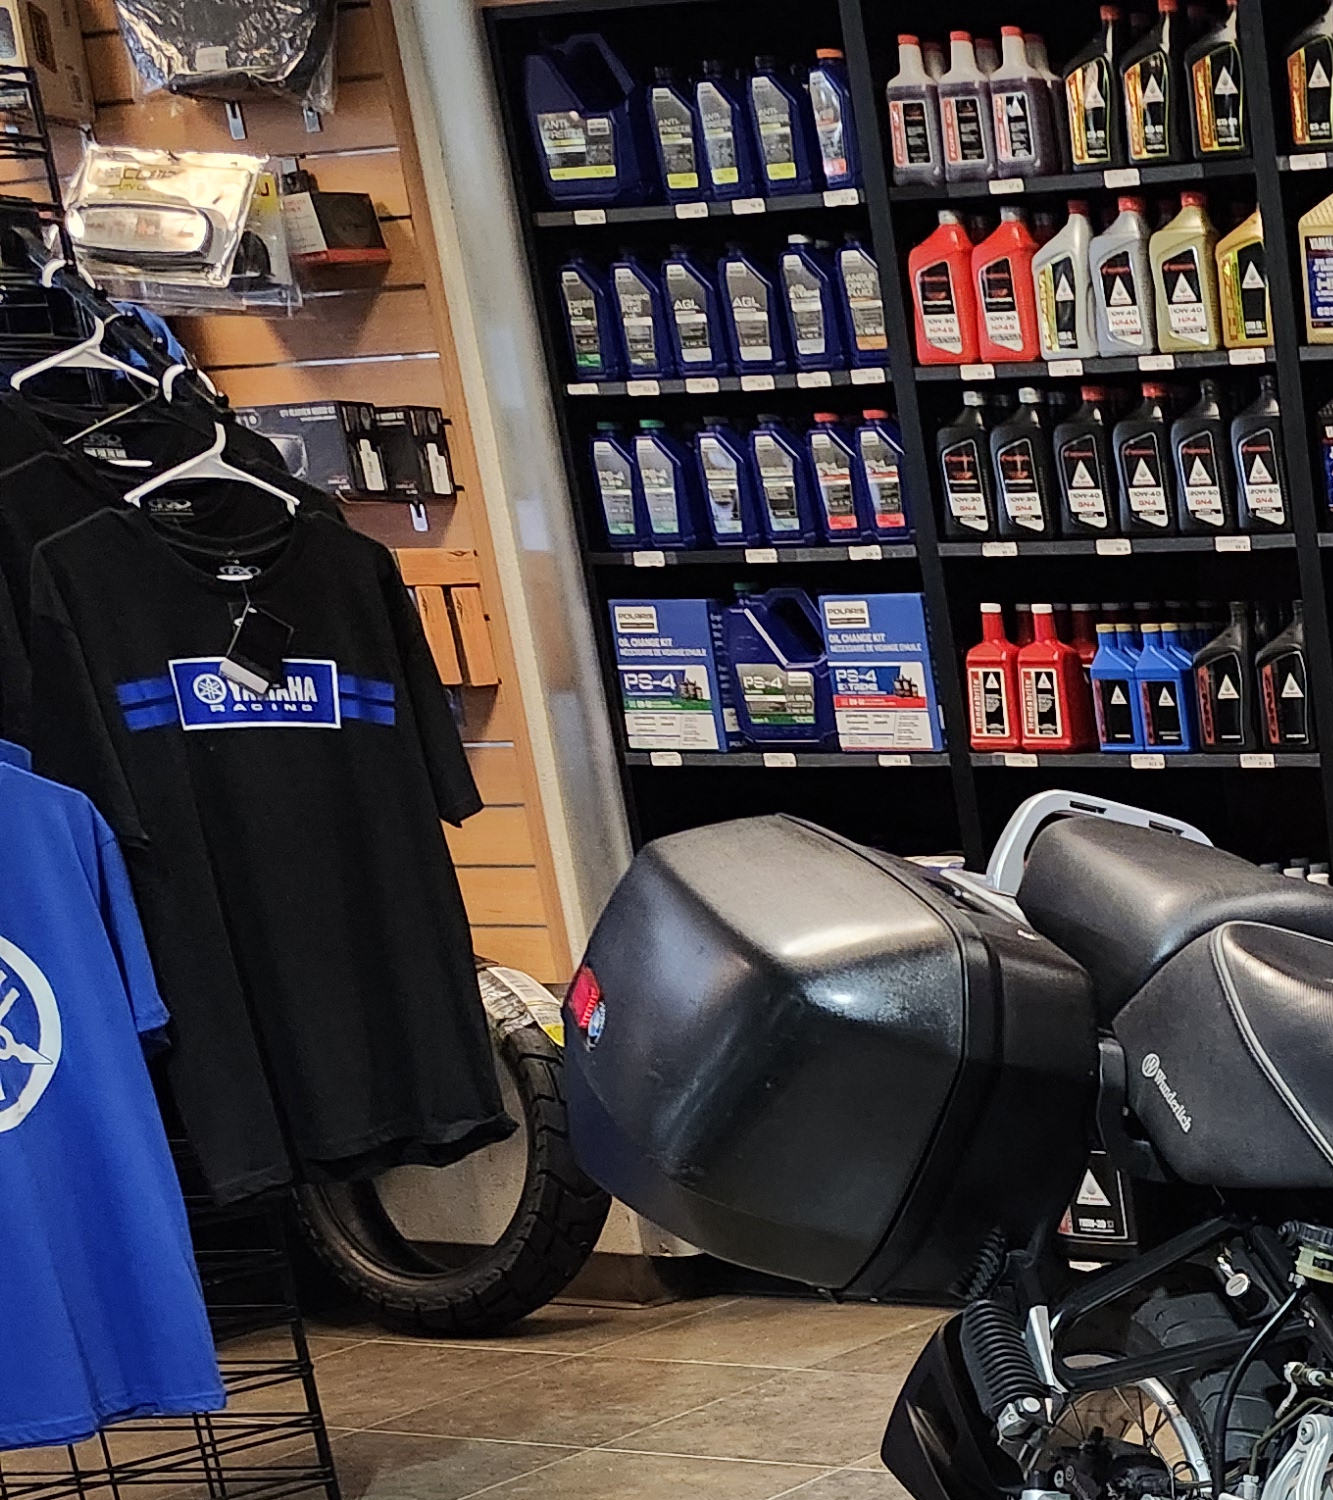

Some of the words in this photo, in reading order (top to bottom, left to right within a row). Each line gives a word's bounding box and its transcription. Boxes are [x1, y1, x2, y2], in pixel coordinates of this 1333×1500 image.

[674, 299, 700, 311] AGL
[733, 297, 761, 308] AGL
[618, 612, 654, 620] POLARIS
[827, 607, 866, 616] POLARIS
[618, 638, 627, 647] OIL
[628, 638, 658, 647] CHANGE
[659, 638, 672, 647] KIT
[828, 634, 838, 643] OIL
[839, 633, 870, 643] CHANGE
[871, 633, 885, 642] KIT
[624, 673, 677, 691] PS-4
[743, 675, 783, 690] PS-4
[836, 669, 877, 684] PS-4
[210, 703, 313, 712] RACING
[973, 678, 982, 729] Hondabrite
[1026, 678, 1035, 729] Hondabrite
[1154, 1068, 1191, 1133] Wunderlich
